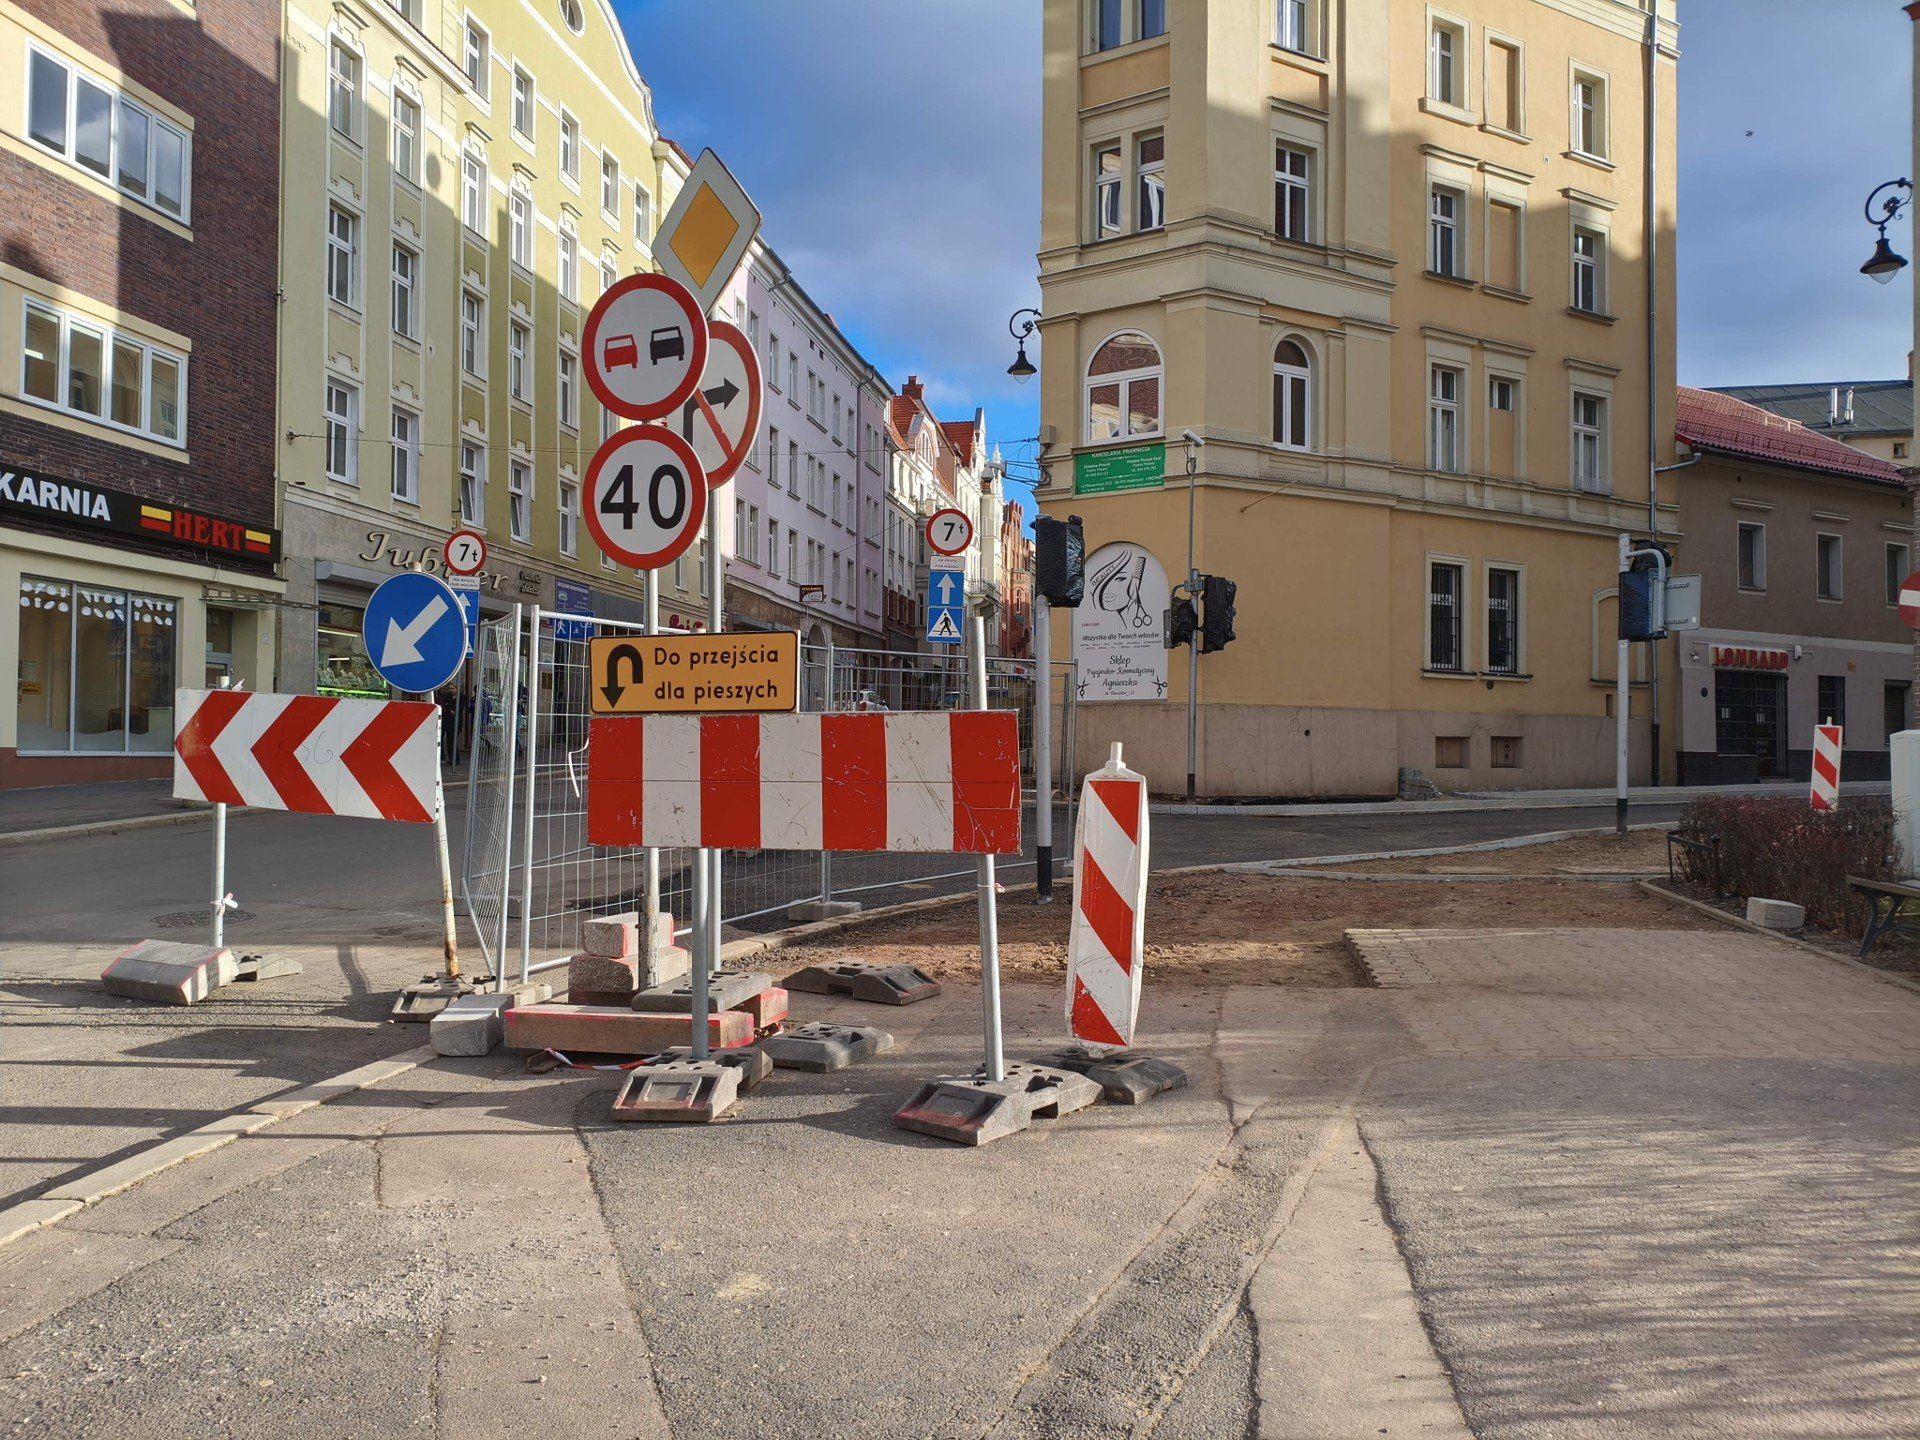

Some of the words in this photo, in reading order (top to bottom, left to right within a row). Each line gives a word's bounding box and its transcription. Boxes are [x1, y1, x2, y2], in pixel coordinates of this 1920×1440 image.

[600, 464, 686, 530] 40
[173, 510, 244, 551] HERT
[654, 647, 681, 665] Do
[690, 644, 778, 670] przejścia
[1110, 655, 1131, 668] Sklep
[1714, 647, 1789, 670] LOMBARD
[655, 681, 684, 700] dla
[694, 680, 778, 704] pieszych
[1102, 678, 1138, 690] Agnieszka
